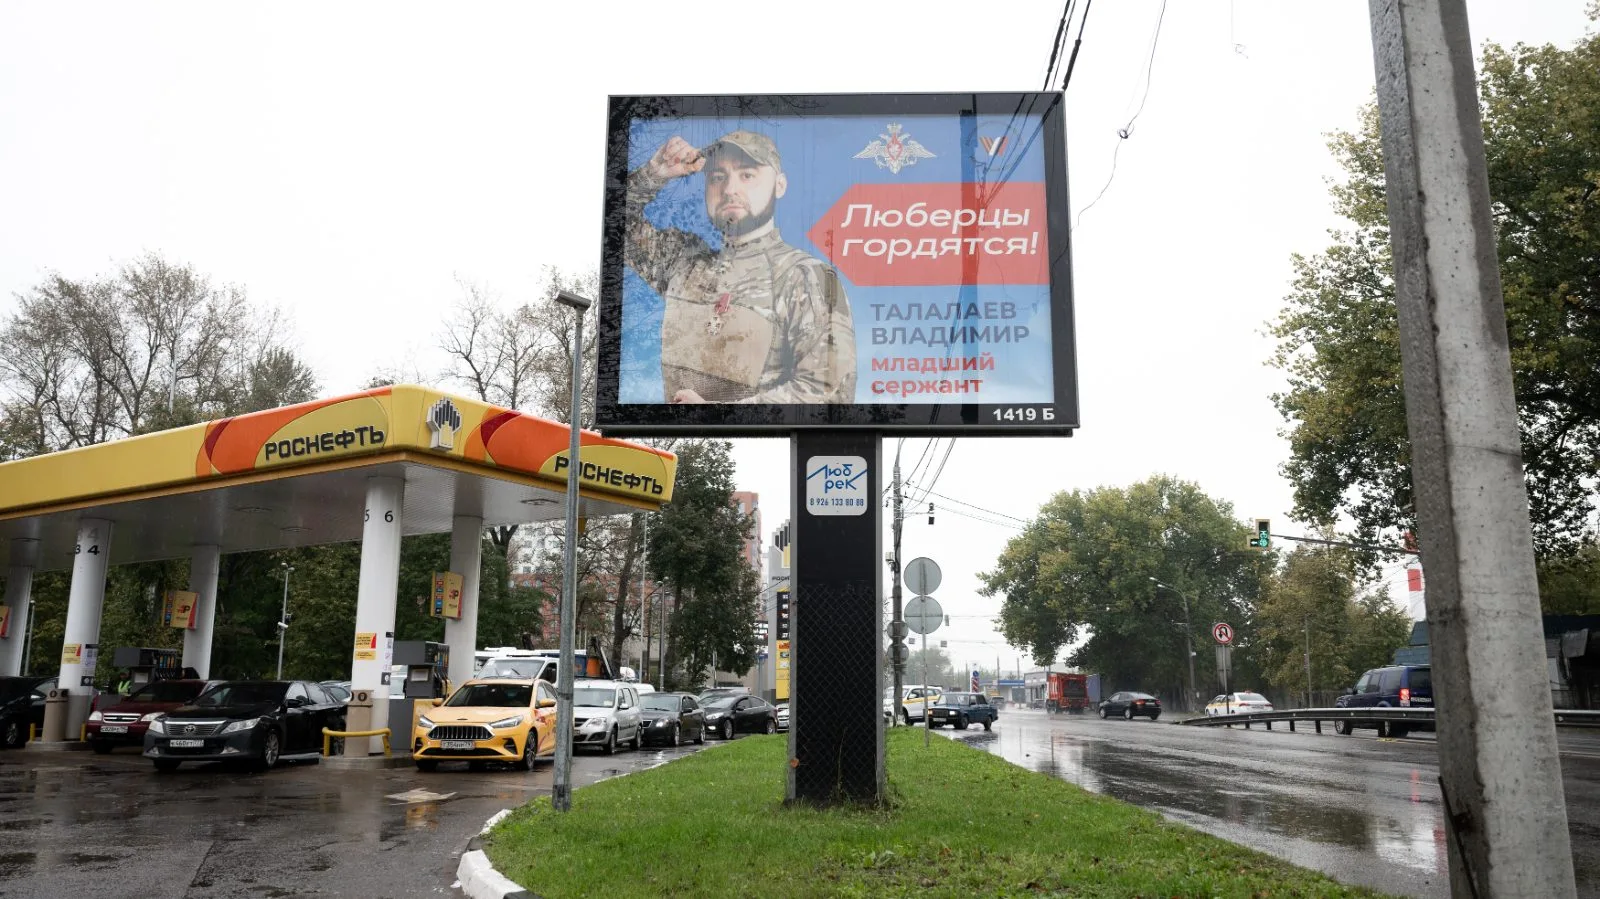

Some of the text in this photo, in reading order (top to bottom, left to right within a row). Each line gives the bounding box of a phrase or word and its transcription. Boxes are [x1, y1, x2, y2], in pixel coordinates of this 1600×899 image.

[841, 202, 1030, 234] Люберцы
[842, 232, 1038, 264] гордятся!
[870, 301, 1017, 321] ТАЛАЛАЕВ
[871, 325, 1030, 347] ВЛАДИМИР
[871, 352, 995, 375] младший
[870, 378, 983, 398] сержант
[993, 409, 1055, 421] 1419 Б
[265, 425, 384, 461] РОСНЕФТЬ
[554, 455, 663, 495] РСНЕФТЬ
[816, 498, 829, 506] 926
[831, 498, 843, 506] 133
[384, 510, 394, 523] 6
[87, 545, 100, 556] 4
